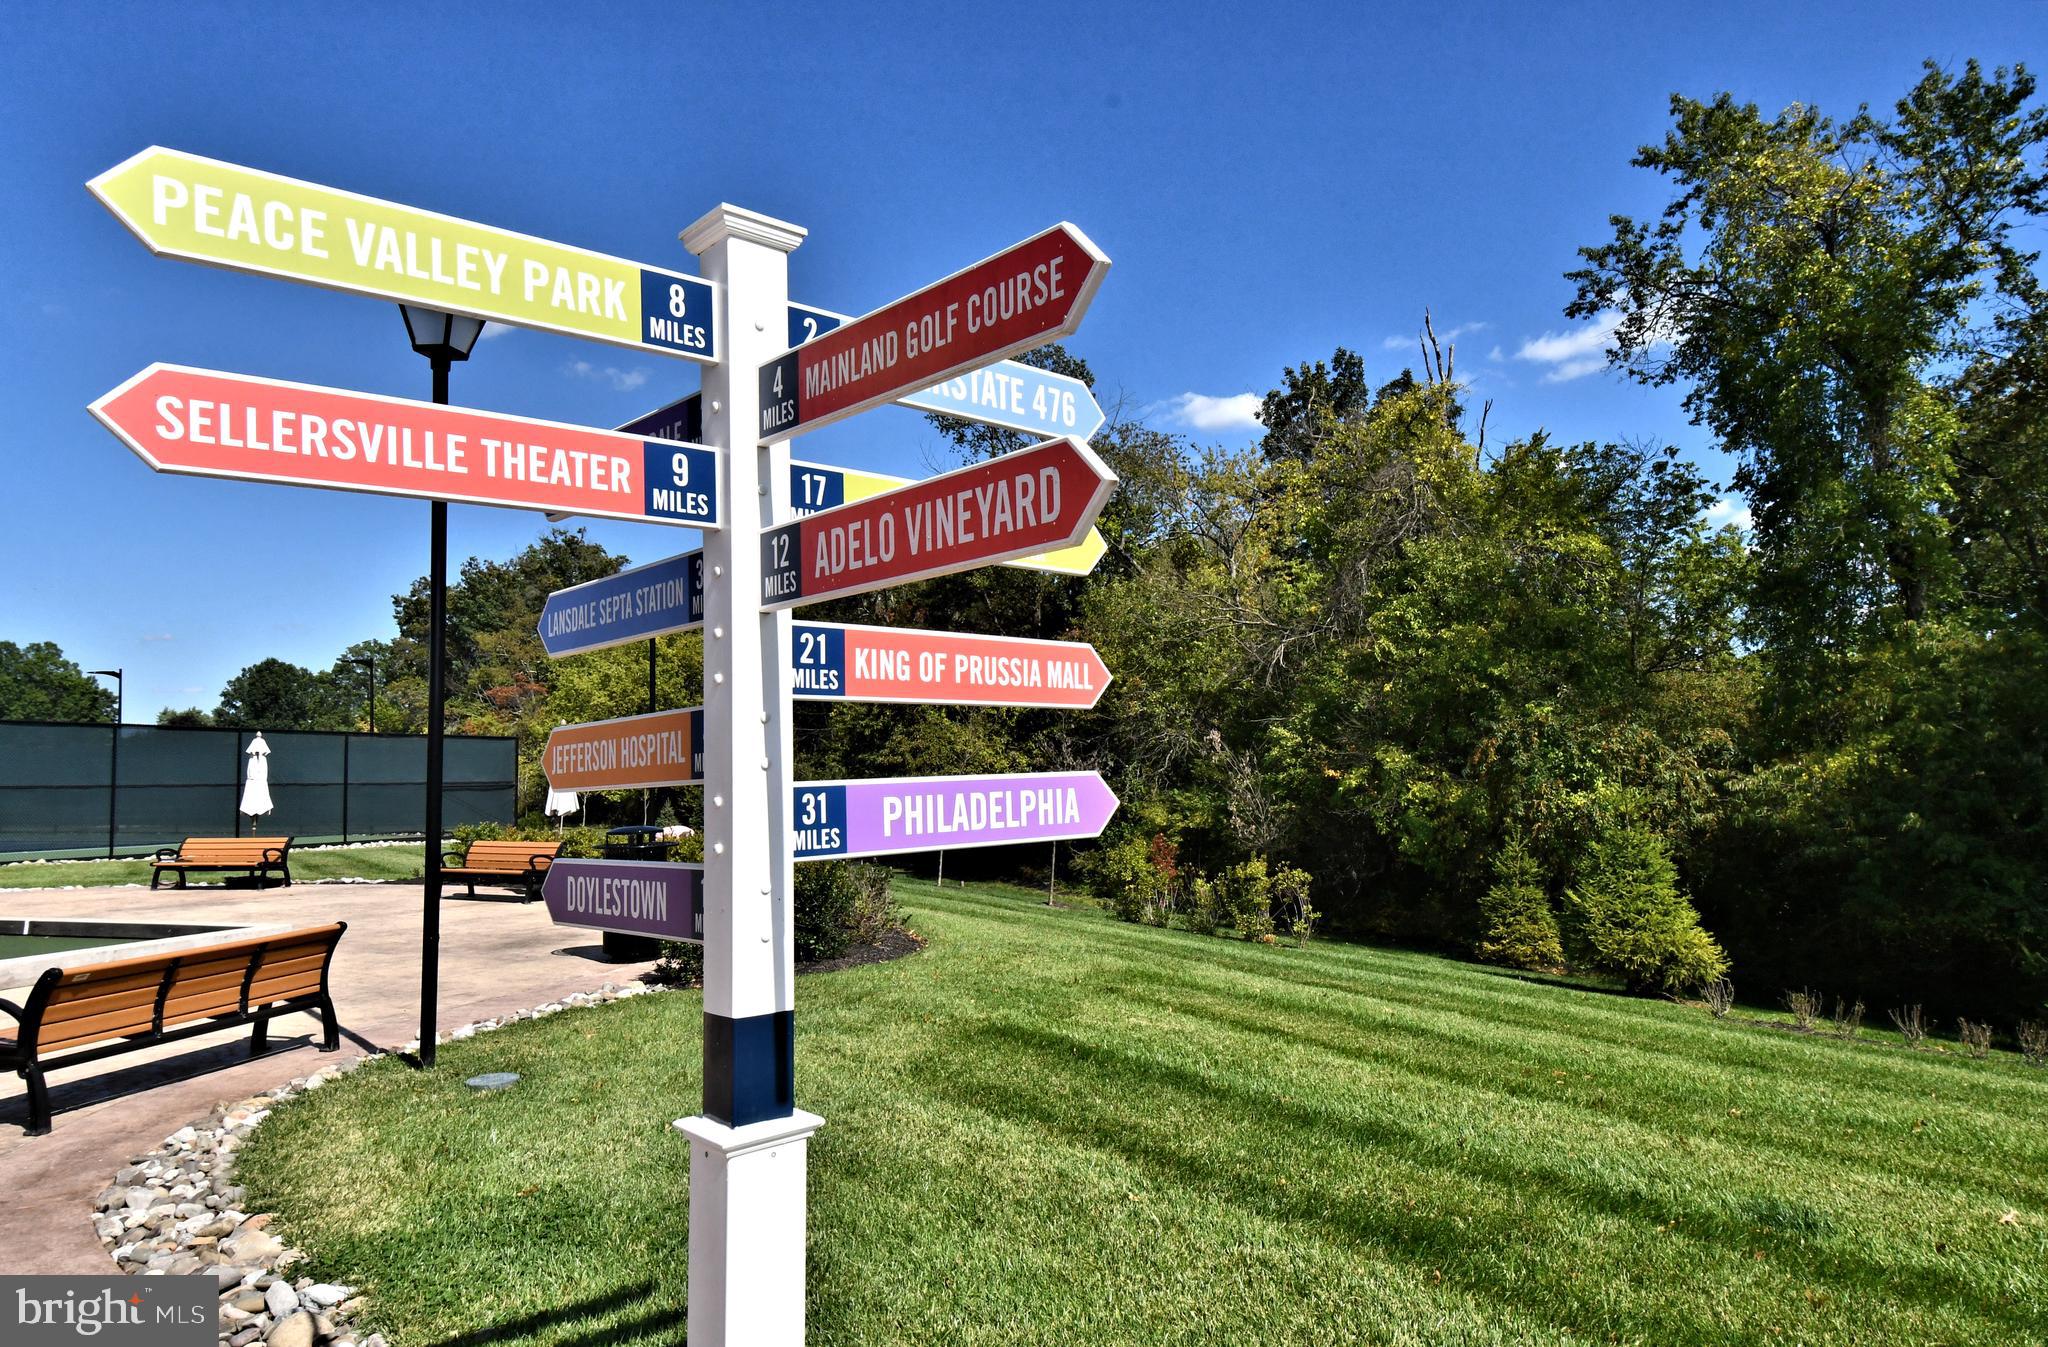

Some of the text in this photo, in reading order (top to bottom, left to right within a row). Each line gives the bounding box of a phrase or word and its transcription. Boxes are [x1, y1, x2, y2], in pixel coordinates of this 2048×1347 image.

[153, 174, 628, 322] PEACE VALLEY PARK
[669, 283, 686, 318] 8
[650, 316, 706, 349] MILES
[805, 255, 1065, 400] MAINLAND GOLF COURSE
[772, 365, 784, 398] 4
[763, 399, 795, 431] MILES
[1032, 384, 1076, 427] 476
[155, 395, 632, 494] SELLERSVILLE THEATER
[671, 452, 690, 487] 9
[652, 487, 709, 516] MILES
[801, 473, 827, 506] 17
[815, 466, 1061, 578] ADELO VINEYARD
[771, 534, 790, 569] 12
[765, 570, 797, 598] MILES
[548, 602, 597, 638] LANSDALE
[599, 591, 633, 625] SEPTA
[635, 577, 684, 616] STATION
[800, 632, 826, 665] 21
[791, 668, 839, 690] MILES
[855, 647, 1094, 691] KING OF PRUSSIA MALL
[552, 738, 617, 775] JEFFERSON
[621, 730, 686, 768] HOSPITAL
[802, 791, 827, 825] 31
[883, 787, 1081, 838] PHILADELPHIA
[793, 827, 841, 851] MILES
[567, 876, 667, 922] DOYLESTOWN
